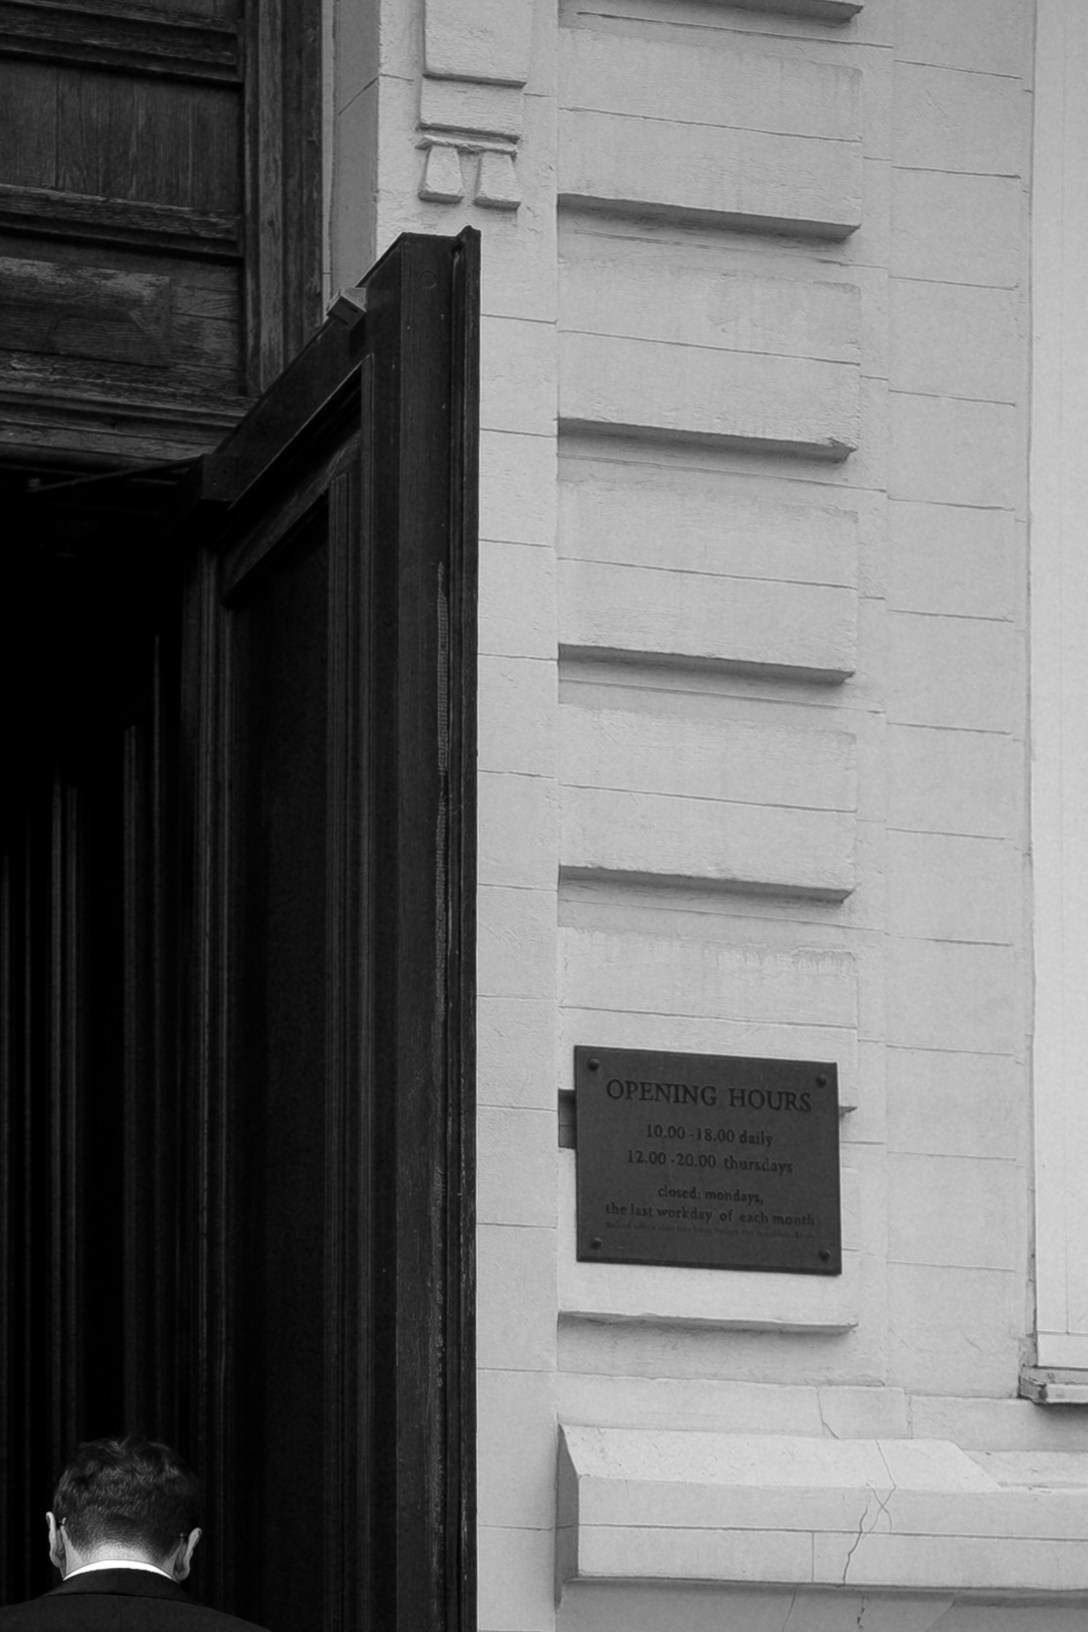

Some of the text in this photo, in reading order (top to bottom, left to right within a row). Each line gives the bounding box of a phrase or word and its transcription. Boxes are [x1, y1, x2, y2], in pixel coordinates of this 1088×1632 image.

[606, 1079, 811, 1113] OPENING HOURS
[646, 1124, 686, 1140] 10.00
[739, 1130, 774, 1148] daily
[627, 1150, 667, 1165] 12.00
[724, 1155, 794, 1176] thursdays
[658, 1185, 701, 1200] closed:
[606, 1202, 815, 1226] the last workday of each month
